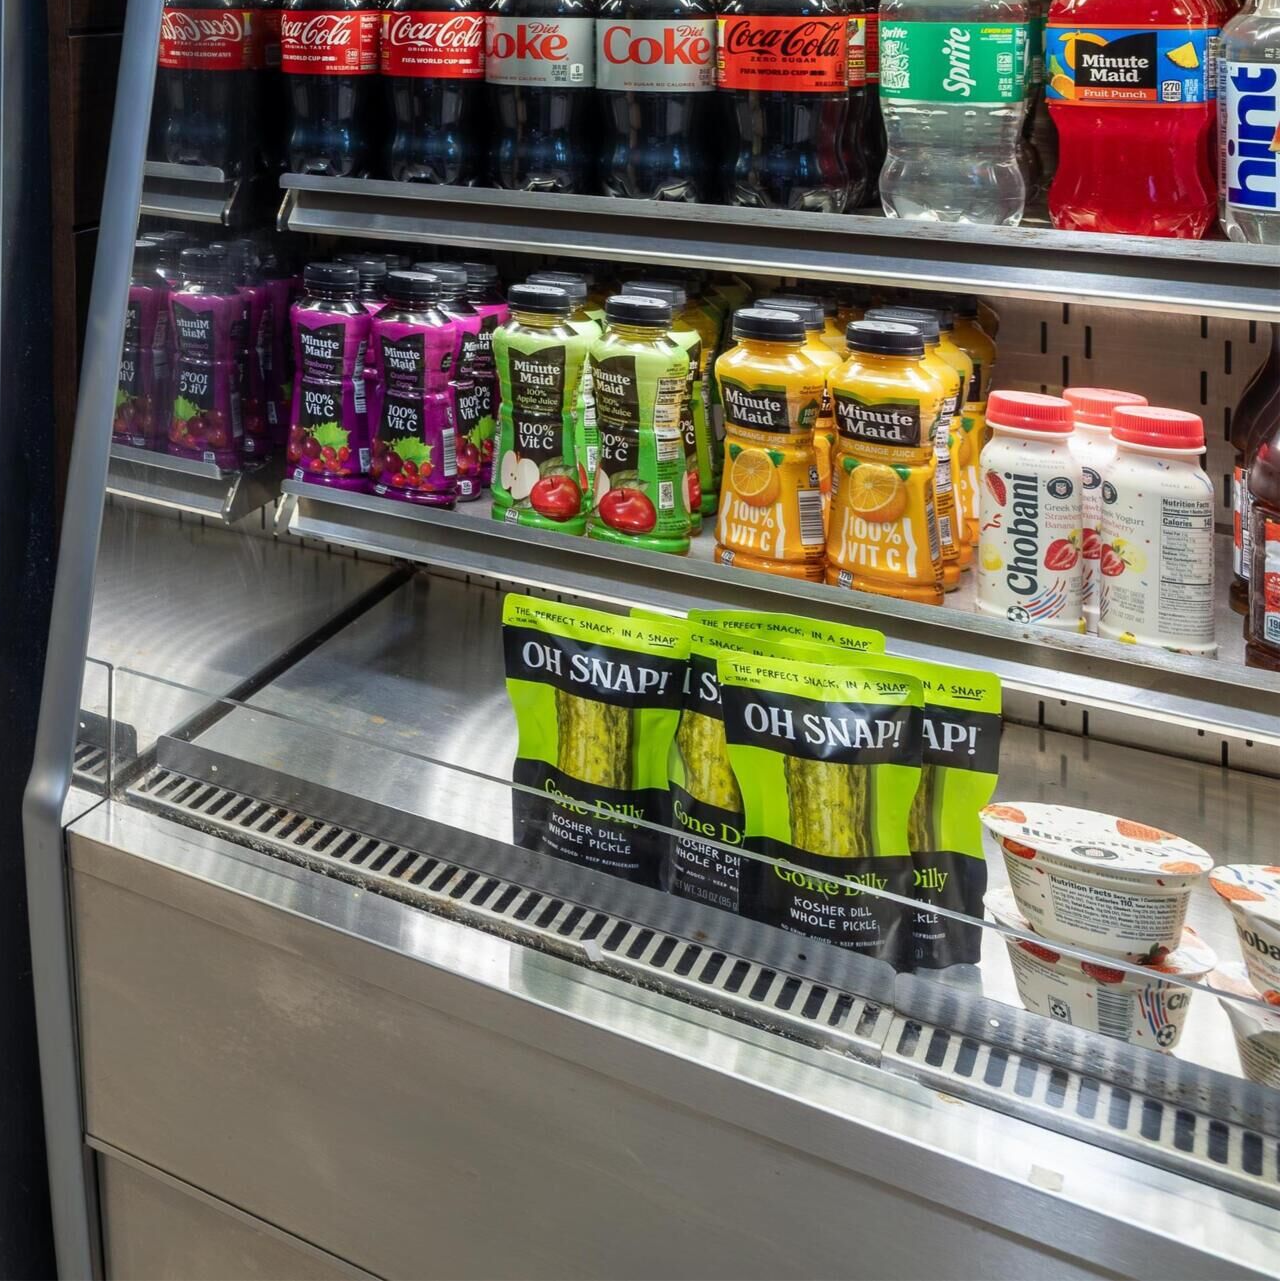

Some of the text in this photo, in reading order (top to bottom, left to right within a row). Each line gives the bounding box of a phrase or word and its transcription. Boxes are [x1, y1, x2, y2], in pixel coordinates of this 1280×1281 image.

[390, 15, 484, 48] Coca-Cola
[527, 22, 561, 35] Diet
[676, 24, 705, 38] Diet
[881, 26, 908, 40] Sprite
[603, 25, 711, 65] Coke
[726, 20, 844, 57] Coca-Cola
[416, 57, 443, 65] WORLD
[941, 26, 977, 97] Sprite
[1081, 53, 1150, 69] Minute
[1089, 68, 1140, 83] Maid
[1083, 89, 1148, 99] Fruit Punch
[1163, 82, 1181, 92] 270
[1228, 66, 1277, 208] hint
[301, 333, 340, 350] Minute
[305, 346, 332, 359] Maid
[383, 346, 421, 360] Minute
[389, 357, 417, 372] Maid
[513, 360, 561, 375] Minute
[519, 372, 555, 386] Maid
[596, 379, 625, 397] Maid
[304, 391, 335, 406] 100%
[725, 387, 782, 412] Minute
[305, 402, 335, 417] Vit C
[387, 404, 418, 421] 100%
[732, 405, 774, 426] Maid
[837, 400, 913, 427] Minute
[387, 415, 418, 432] Vit C
[518, 421, 555, 437] 100%
[844, 417, 904, 442] Maid
[519, 434, 554, 450] Vit C
[615, 448, 628, 462] C
[1044, 503, 1071, 512] Greek
[1162, 498, 1196, 509] Nutrition
[732, 500, 775, 529] 100%
[1115, 511, 1145, 528] Yogurt
[1162, 518, 1193, 528] Calories
[730, 523, 771, 552] VIT C
[848, 515, 903, 545] 100%
[1004, 472, 1039, 596] Chobani
[846, 541, 902, 572] VIT C
[515, 605, 644, 640] THE PERFECT SNACK, IN A
[702, 618, 836, 643] THE PERFECT SNACK, IN A
[522, 641, 671, 696] OH SNAP!
[732, 663, 872, 691] THE PERFECT SNACK, IN A
[744, 702, 904, 751] OH SNAP!
[544, 778, 644, 830] Gone Dilly
[552, 811, 627, 843] KOSHER DILL
[673, 799, 716, 836] Gone
[547, 822, 632, 855] WHOLE PICKLE
[844, 872, 889, 899] Dilly
[1049, 874, 1113, 898] Nutrition Facts
[793, 895, 873, 918] KOSHER DILL
[1095, 895, 1120, 906] Calories
[789, 907, 878, 932] WHOLE PICKLE
